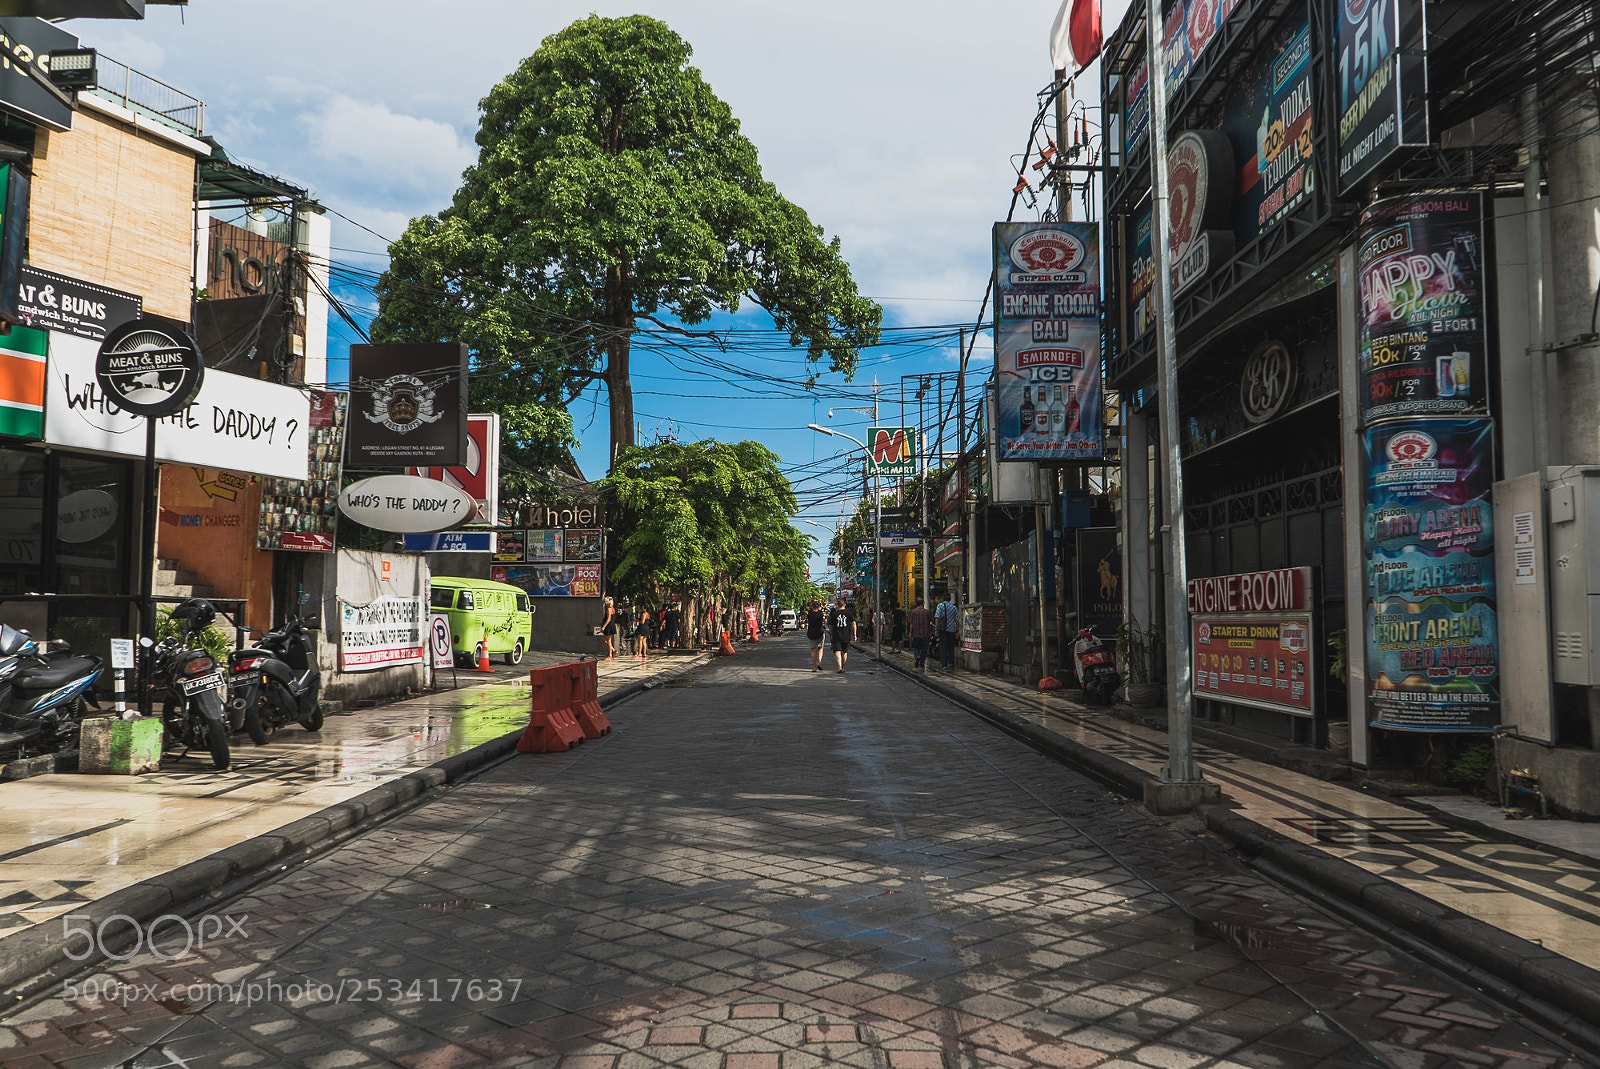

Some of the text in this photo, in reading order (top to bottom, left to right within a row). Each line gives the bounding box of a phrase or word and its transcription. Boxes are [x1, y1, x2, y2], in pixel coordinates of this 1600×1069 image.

[1367, 57, 1393, 108] DRAFT
[1280, 75, 1312, 133] VODKA
[1340, 113, 1395, 178] ALL NIGHT LONG
[1263, 140, 1300, 196] TEQUILA
[1411, 202, 1443, 213] ROOM
[1445, 200, 1469, 212] BALI
[1373, 233, 1404, 257] FLOOR
[1183, 244, 1204, 282] CLUB
[1053, 274, 1079, 282] CLUB
[1361, 250, 1456, 318] HAPPY
[62, 294, 106, 320] BUNS
[1003, 293, 1095, 316] ENGINE ROOM
[62, 313, 80, 324] bar
[1409, 307, 1459, 324] ALL NIGHT
[1033, 321, 1067, 340] BALI
[1432, 321, 1443, 333] 2
[1445, 319, 1469, 332] FOR
[1372, 330, 1428, 350] BEER BINTANG
[1409, 344, 1426, 352] FOR
[109, 352, 183, 368] MEAT & BUNS
[1023, 351, 1077, 364] SMIRNOFF
[1412, 351, 1422, 361] 2
[1031, 366, 1072, 381] ICE
[1402, 378, 1421, 386] FOR
[1406, 386, 1416, 396] 2
[1399, 401, 1438, 411] IMPORTED
[1439, 400, 1467, 409] BRAND
[213, 405, 299, 449] DADDY ?
[1007, 441, 1015, 450] We
[1016, 442, 1031, 450] Serve
[1046, 441, 1063, 450] Better
[1065, 441, 1078, 449] Than
[1079, 441, 1097, 449] Others
[218, 471, 246, 490] Cones
[348, 493, 380, 508] WHO'S
[386, 496, 408, 510] THE
[412, 498, 448, 513] DADDY
[452, 498, 462, 514] ?
[547, 505, 597, 526] hotel
[1384, 508, 1406, 518] FLOOR
[1424, 505, 1481, 533] ARENA
[180, 514, 203, 527] MONEY
[1420, 529, 1452, 541] Happy
[1438, 535, 1477, 548] all night
[451, 542, 466, 551] BCA
[1385, 561, 1408, 571] FLOOR
[578, 570, 598, 578] POOL
[1417, 561, 1481, 591] ARENA
[1187, 569, 1293, 612] ENGINE ROOM
[1093, 603, 1122, 613] POLO
[1383, 614, 1403, 623] FLOOR
[1212, 626, 1248, 637] STARTER
[1250, 627, 1279, 639] DRINK
[1378, 616, 1483, 643] FRONT ARENA
[1423, 639, 1453, 649] NIGHT
[1453, 638, 1471, 647] LIFE
[1401, 644, 1496, 671] RED ARENA
[1400, 691, 1426, 702] BETTER
[1428, 692, 1447, 703] THAN
[1449, 693, 1463, 703] THE
[1464, 693, 1490, 703] OTHERS
